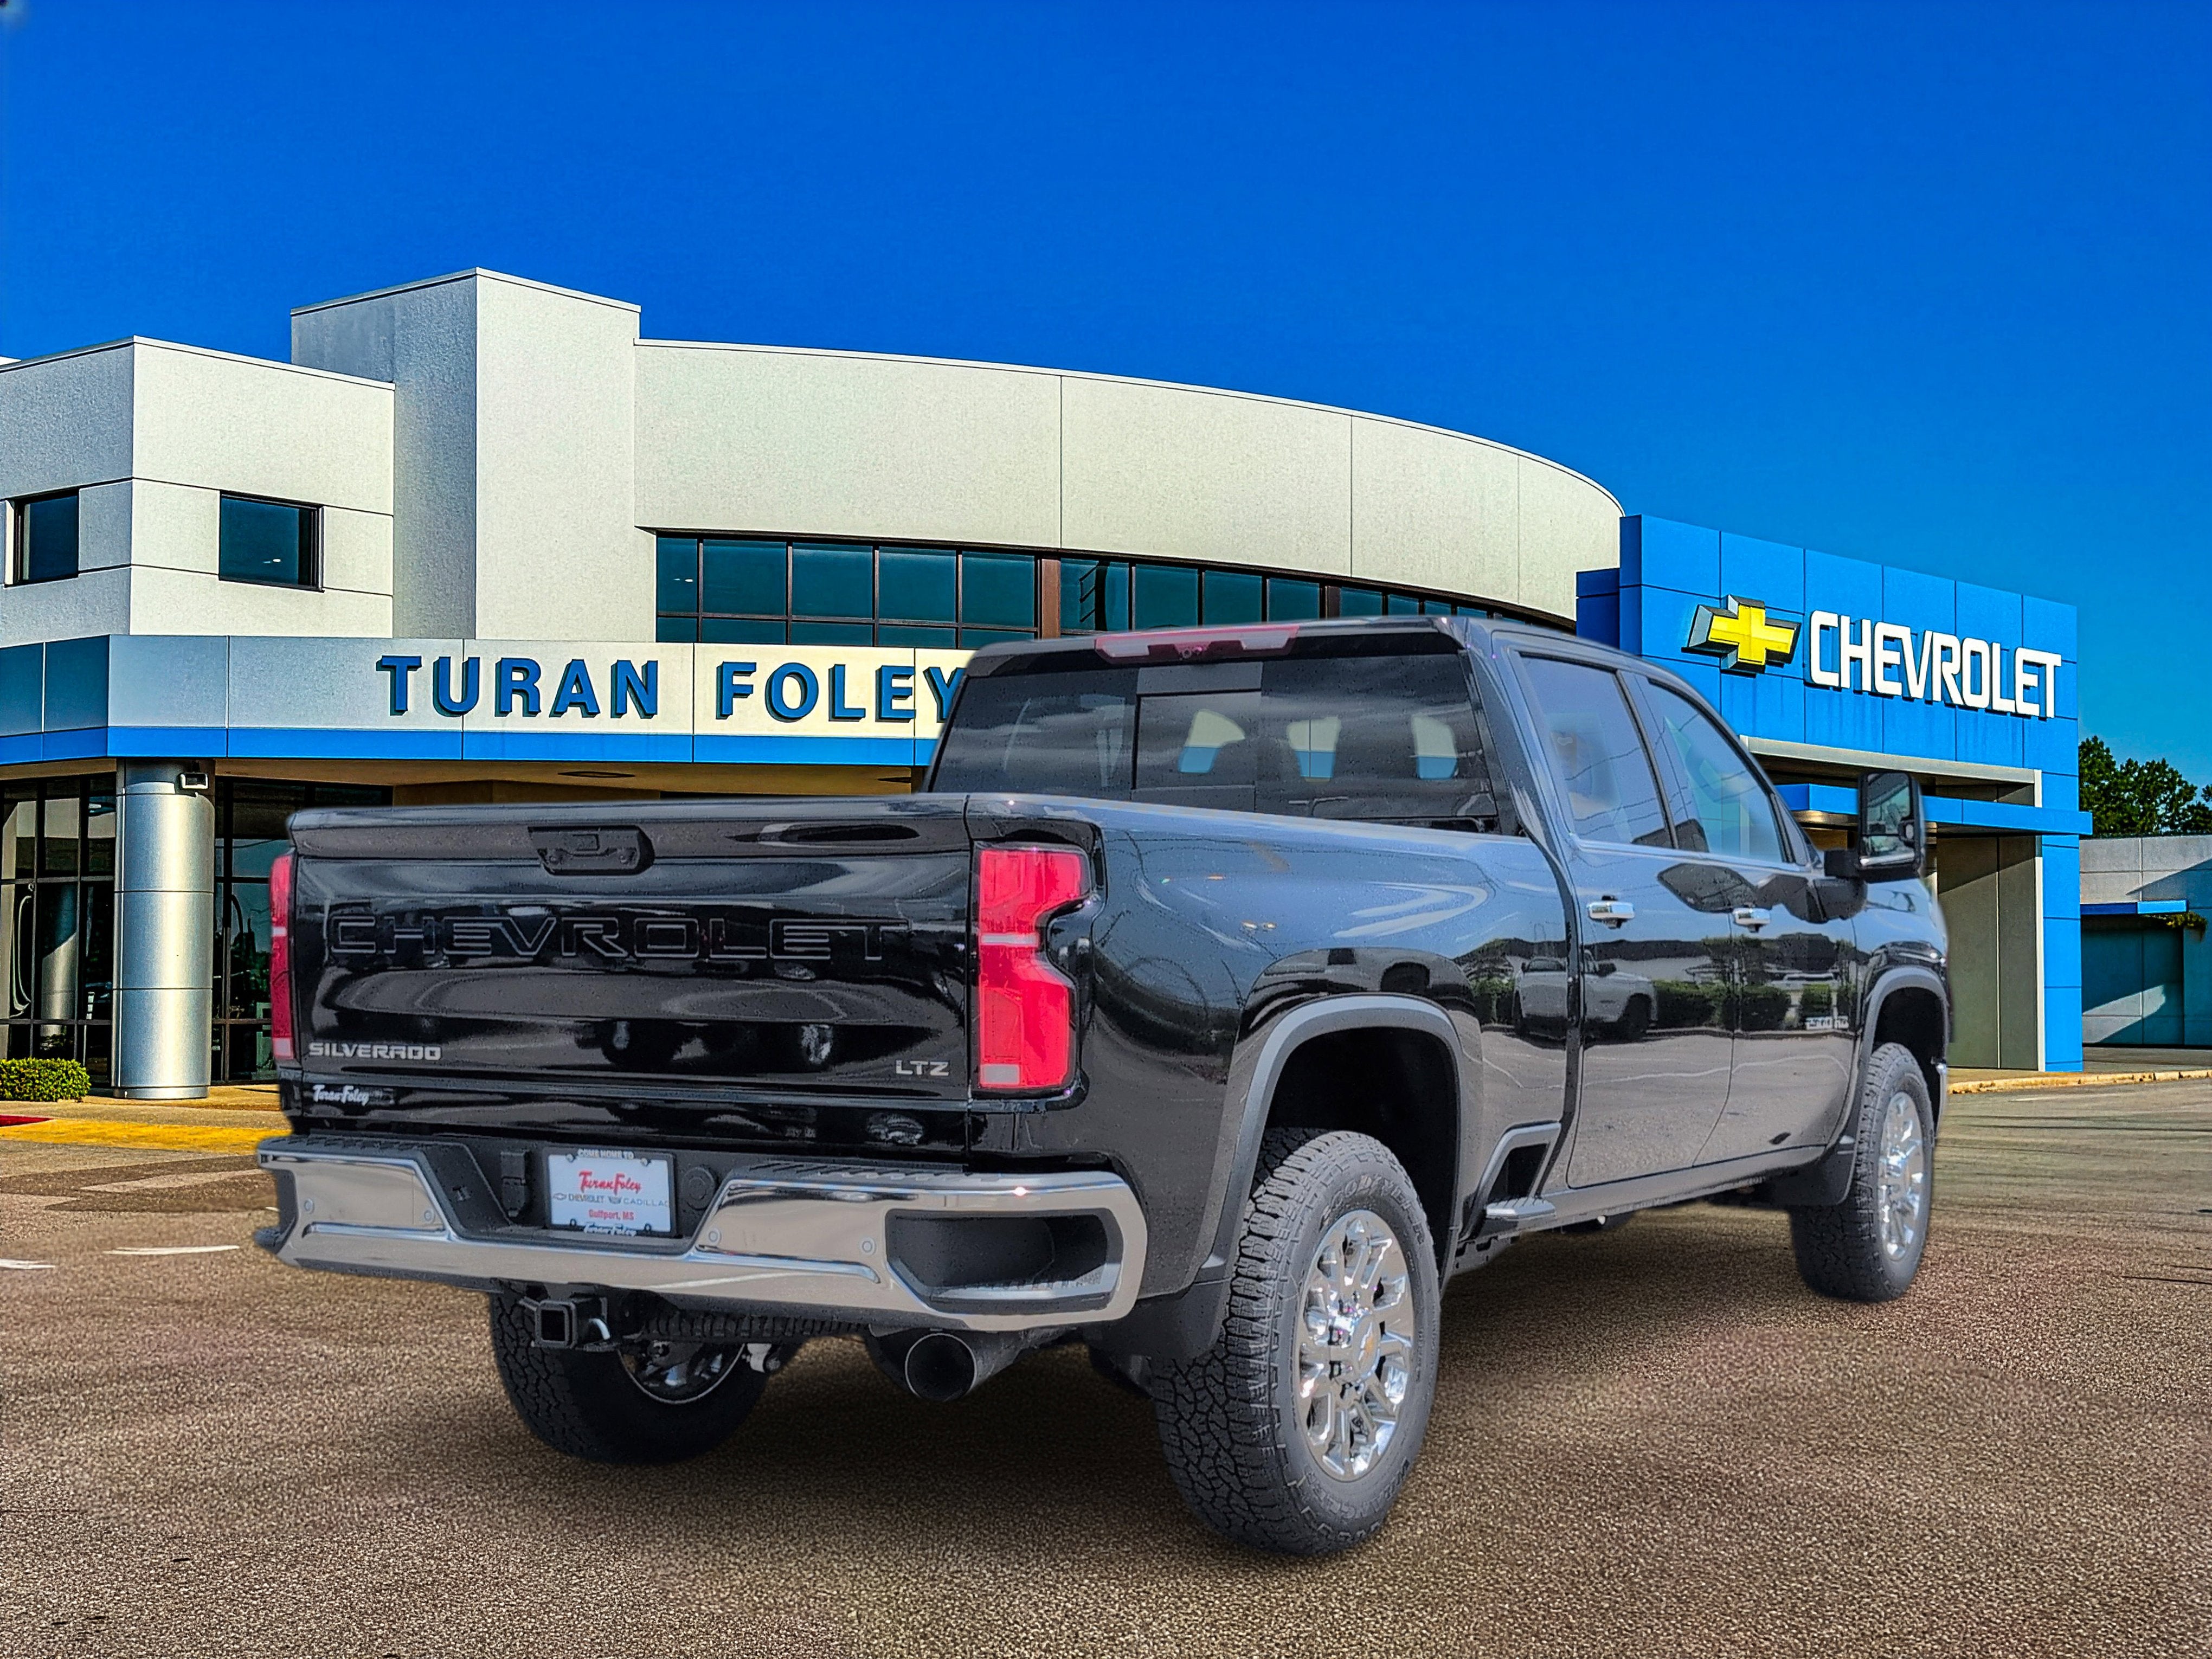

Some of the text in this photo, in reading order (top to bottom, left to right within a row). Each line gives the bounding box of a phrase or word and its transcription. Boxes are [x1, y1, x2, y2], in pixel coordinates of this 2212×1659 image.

[1810, 609, 2062, 718] CHEVROLET
[376, 655, 966, 723] TURAN FOLEY
[330, 916, 912, 960] CHEVROLET
[308, 1042, 442, 1060] SILVERADO
[896, 1059, 949, 1076] LTZ
[622, 1211, 634, 1220] MS
